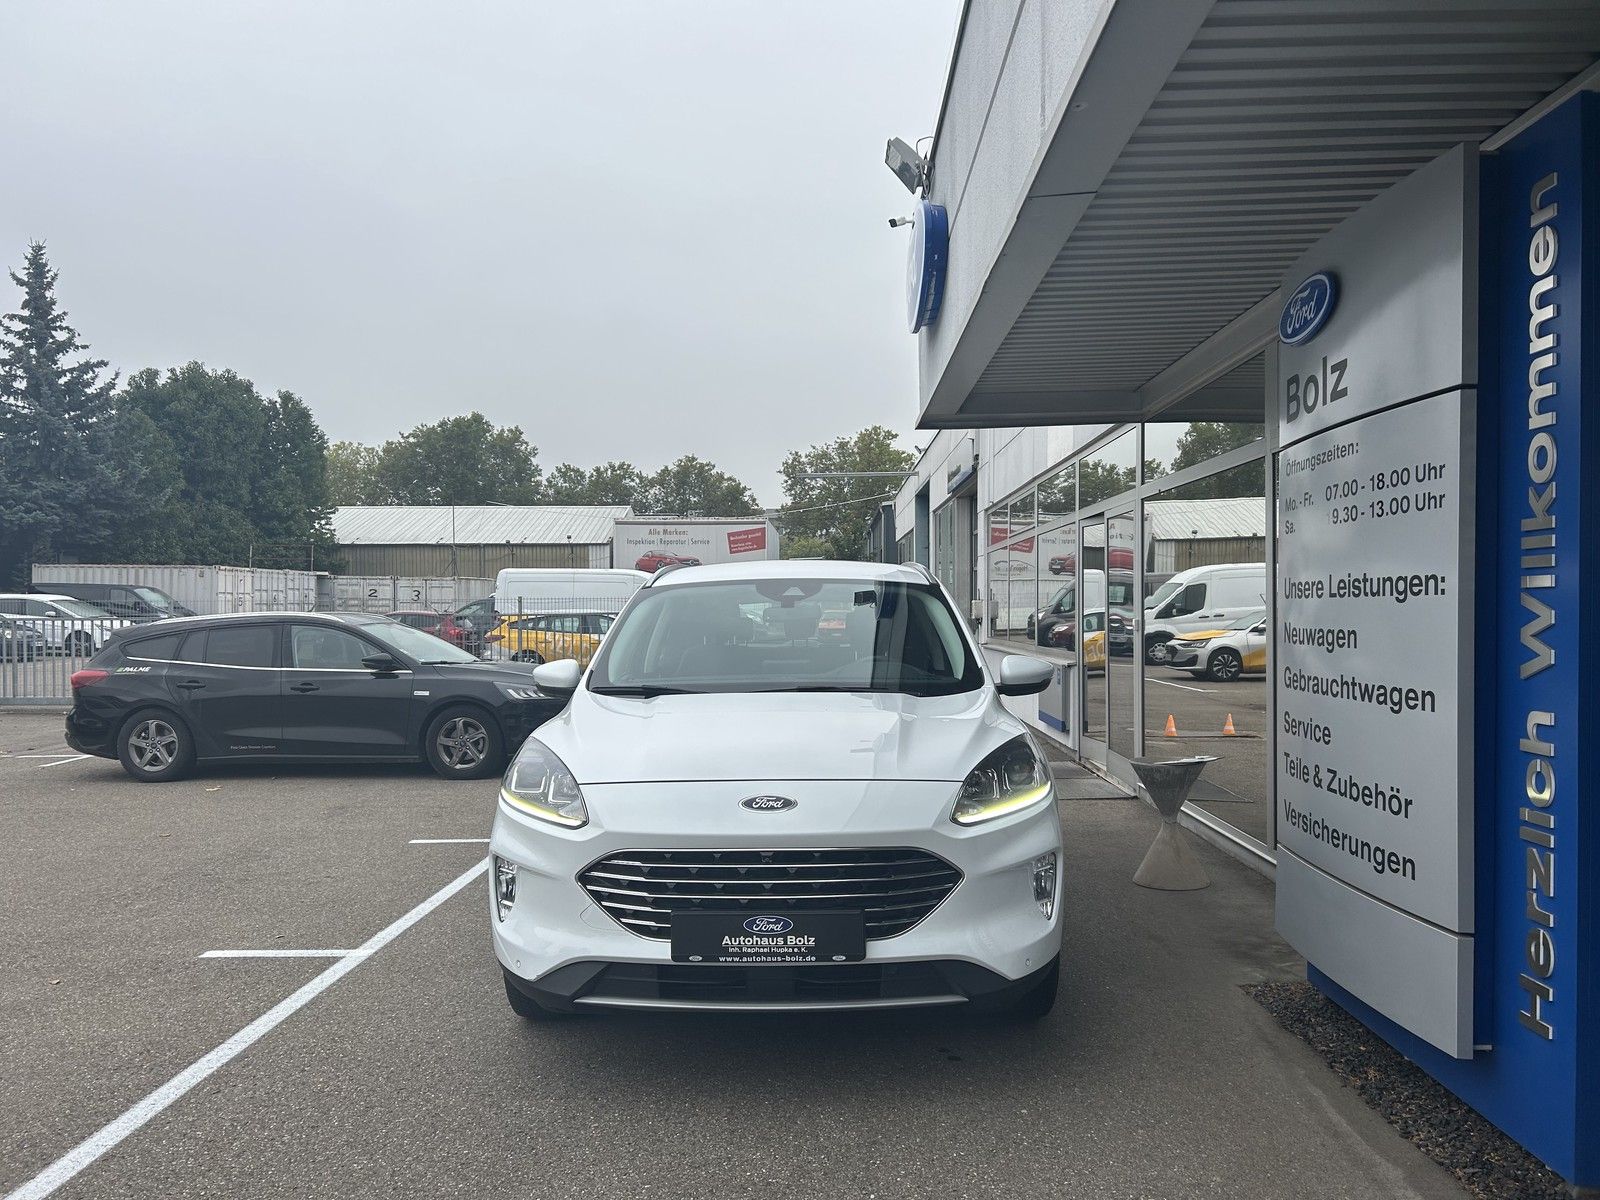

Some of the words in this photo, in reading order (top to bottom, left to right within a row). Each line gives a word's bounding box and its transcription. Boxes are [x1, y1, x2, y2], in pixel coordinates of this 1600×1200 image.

[1287, 287, 1318, 334] Ford
[1286, 356, 1348, 424] Bolz
[1520, 171, 1559, 681] Willkommen
[1285, 442, 1359, 476] Öffnungszeiten:
[1304, 492, 1314, 507] Fr.
[1325, 479, 1358, 501] 07.00
[1370, 467, 1410, 492] 18.00
[1415, 462, 1446, 482] Uhr
[1285, 520, 1296, 535] Sa.
[1370, 495, 1410, 519] 13.00
[1415, 492, 1446, 512] Uhr
[626, 538, 655, 546] Inspektion
[659, 538, 687, 546] Reparatur
[648, 528, 661, 536] Alle
[663, 528, 688, 536] Marken:
[367, 589, 378, 598] 2
[411, 590, 421, 602] 3
[1284, 577, 1324, 599] Unsere
[1329, 573, 1446, 603] Leistungen:
[1284, 622, 1357, 653] Neuwagen
[1284, 666, 1436, 714] Gebrauchtwagen
[1284, 711, 1331, 745] Service
[752, 796, 784, 808] Ford
[1284, 752, 1310, 783] Teile
[1313, 764, 1323, 789] &
[1326, 768, 1413, 819] Zubehör
[1284, 798, 1416, 881] Versicherungen
[1518, 710, 1556, 1041] Herzlich
[722, 935, 784, 945] Autohaus
[787, 935, 816, 945] Bolz
[752, 918, 784, 932] Ford
[742, 946, 770, 954] Raphael
[771, 946, 793, 954] Hupka
